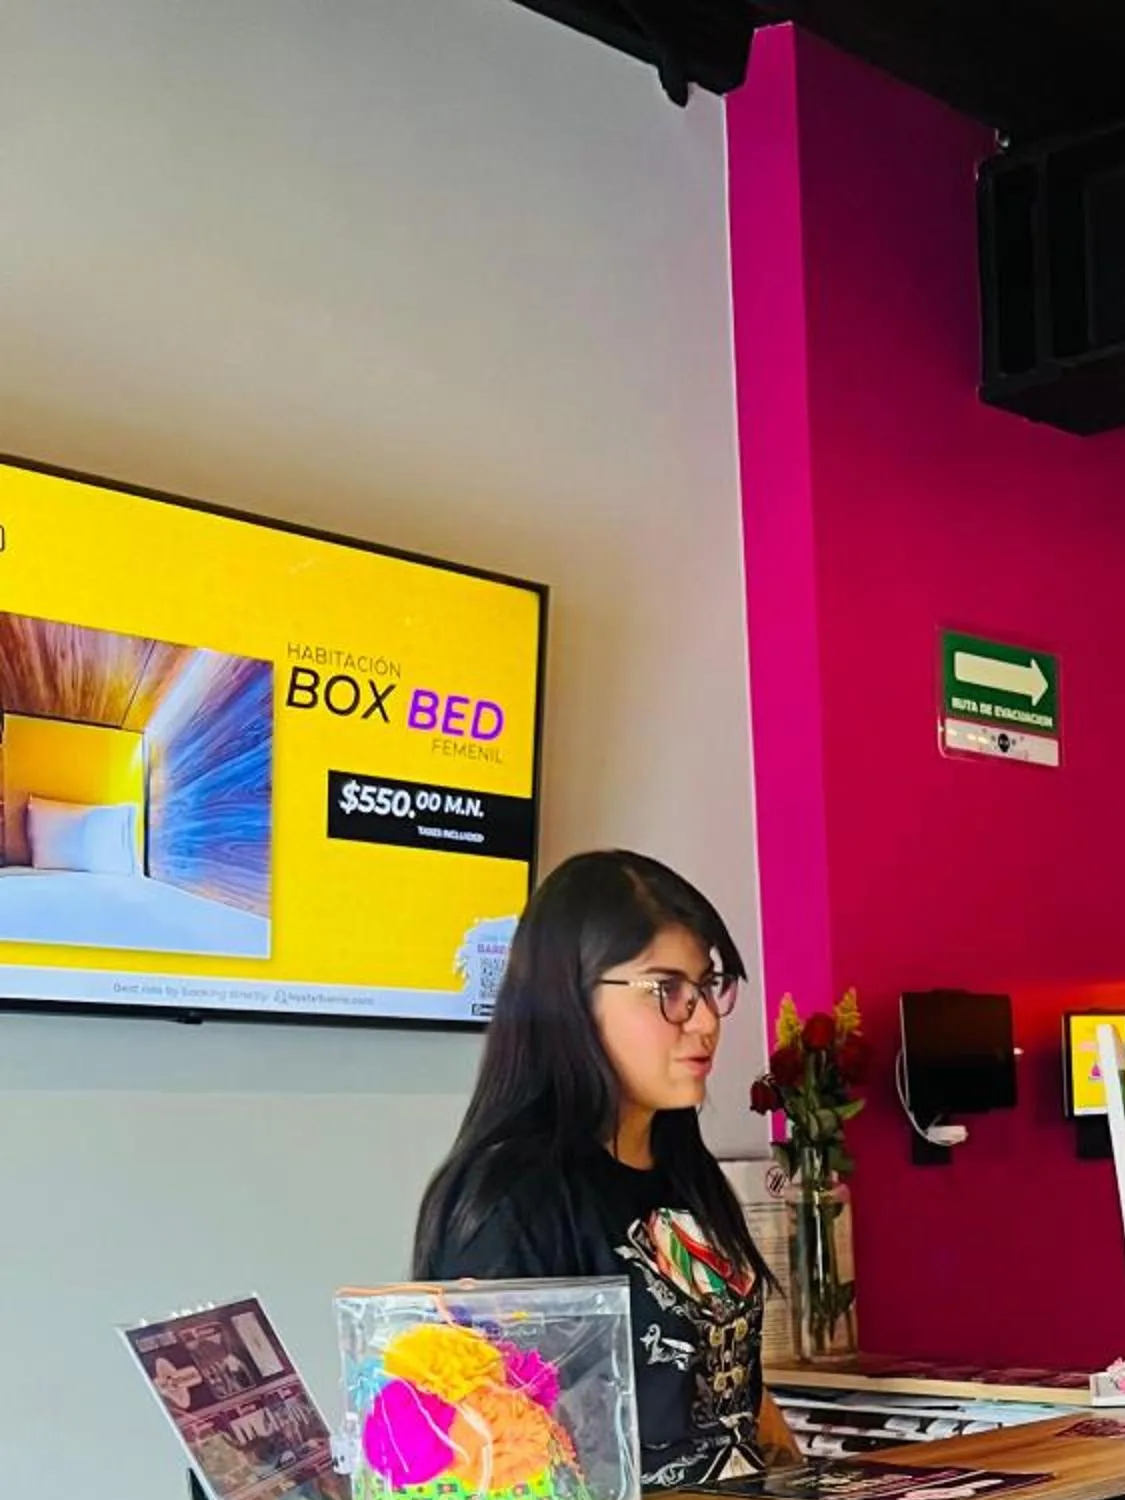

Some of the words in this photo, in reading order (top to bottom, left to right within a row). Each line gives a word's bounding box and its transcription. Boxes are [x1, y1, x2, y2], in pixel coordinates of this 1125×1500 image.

[287, 641, 401, 678] HABITACIÓN
[285, 665, 397, 724] BOX
[407, 688, 505, 742] BED
[951, 696, 979, 713] RUTA
[979, 702, 993, 716] DE
[431, 738, 504, 764] FEMENIL
[339, 780, 441, 819] $550.00
[443, 793, 485, 818] M.N.
